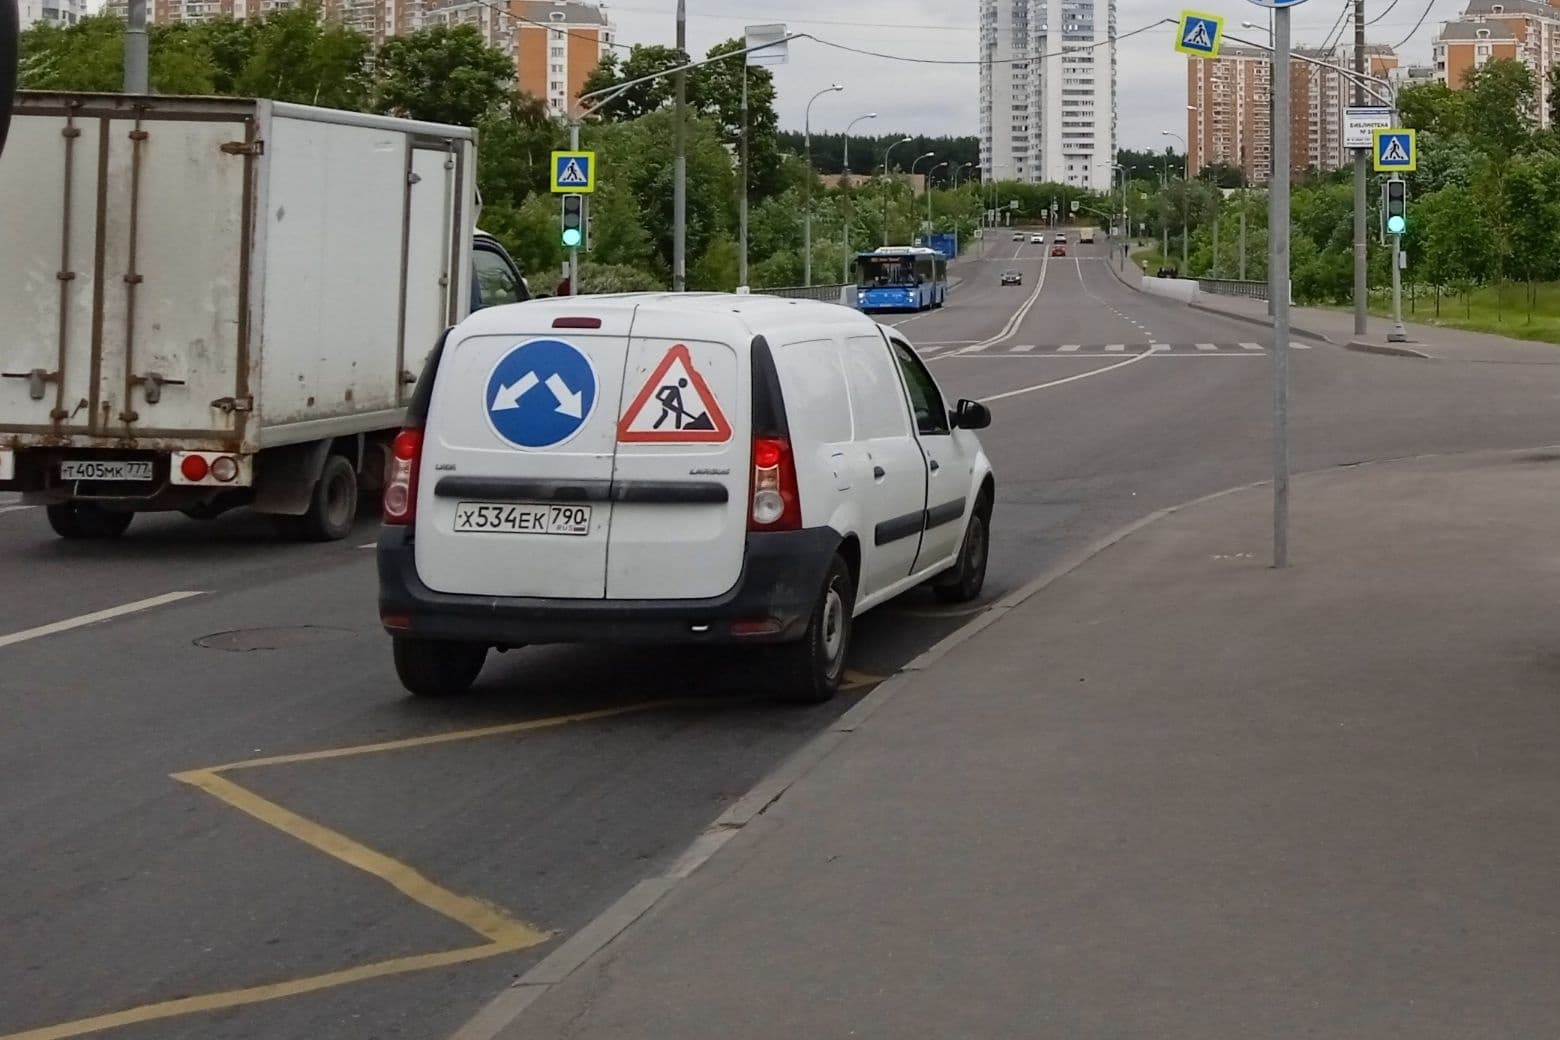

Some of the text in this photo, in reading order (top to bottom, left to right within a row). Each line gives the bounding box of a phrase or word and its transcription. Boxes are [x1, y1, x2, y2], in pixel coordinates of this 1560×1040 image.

[127, 463, 149, 474] 777
[461, 507, 584, 530] Х534ЕК 790
